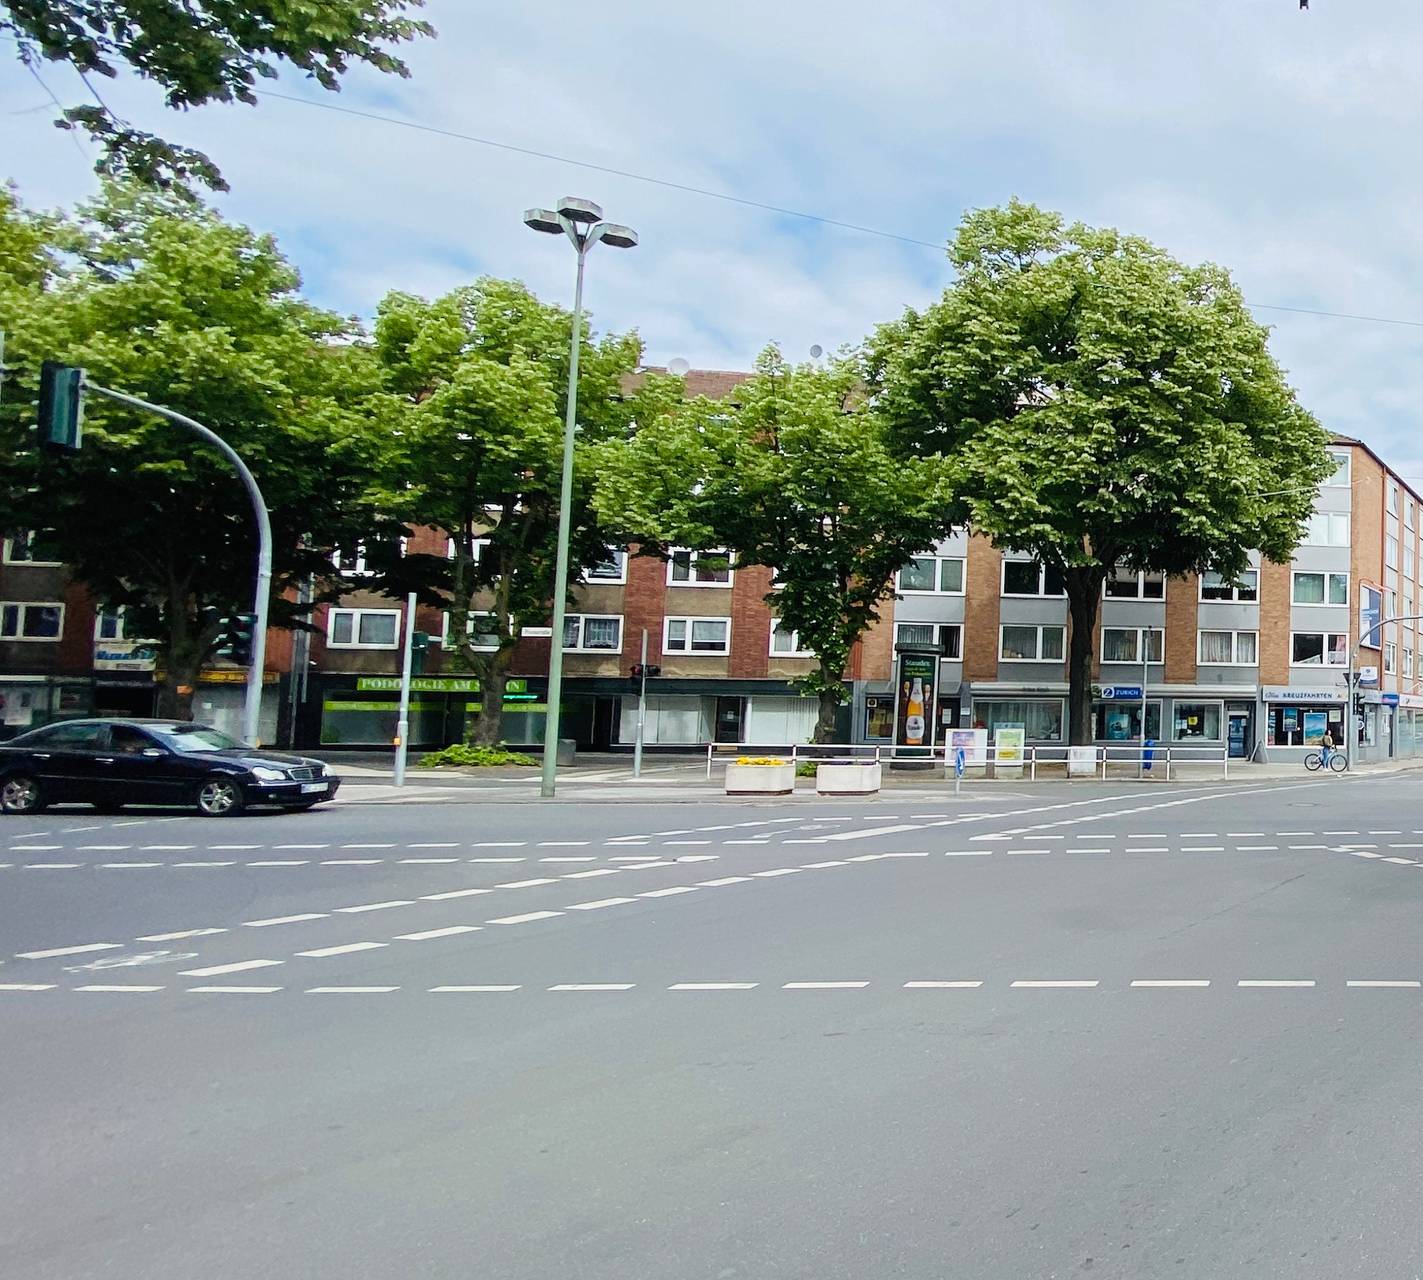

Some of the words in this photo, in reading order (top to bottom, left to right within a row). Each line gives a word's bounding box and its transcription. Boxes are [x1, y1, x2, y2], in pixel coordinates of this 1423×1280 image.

[362, 679, 447, 690] PODOOGIE
[450, 680, 472, 691] AM
[1282, 691, 1333, 699] KREUZFAHRTEN
